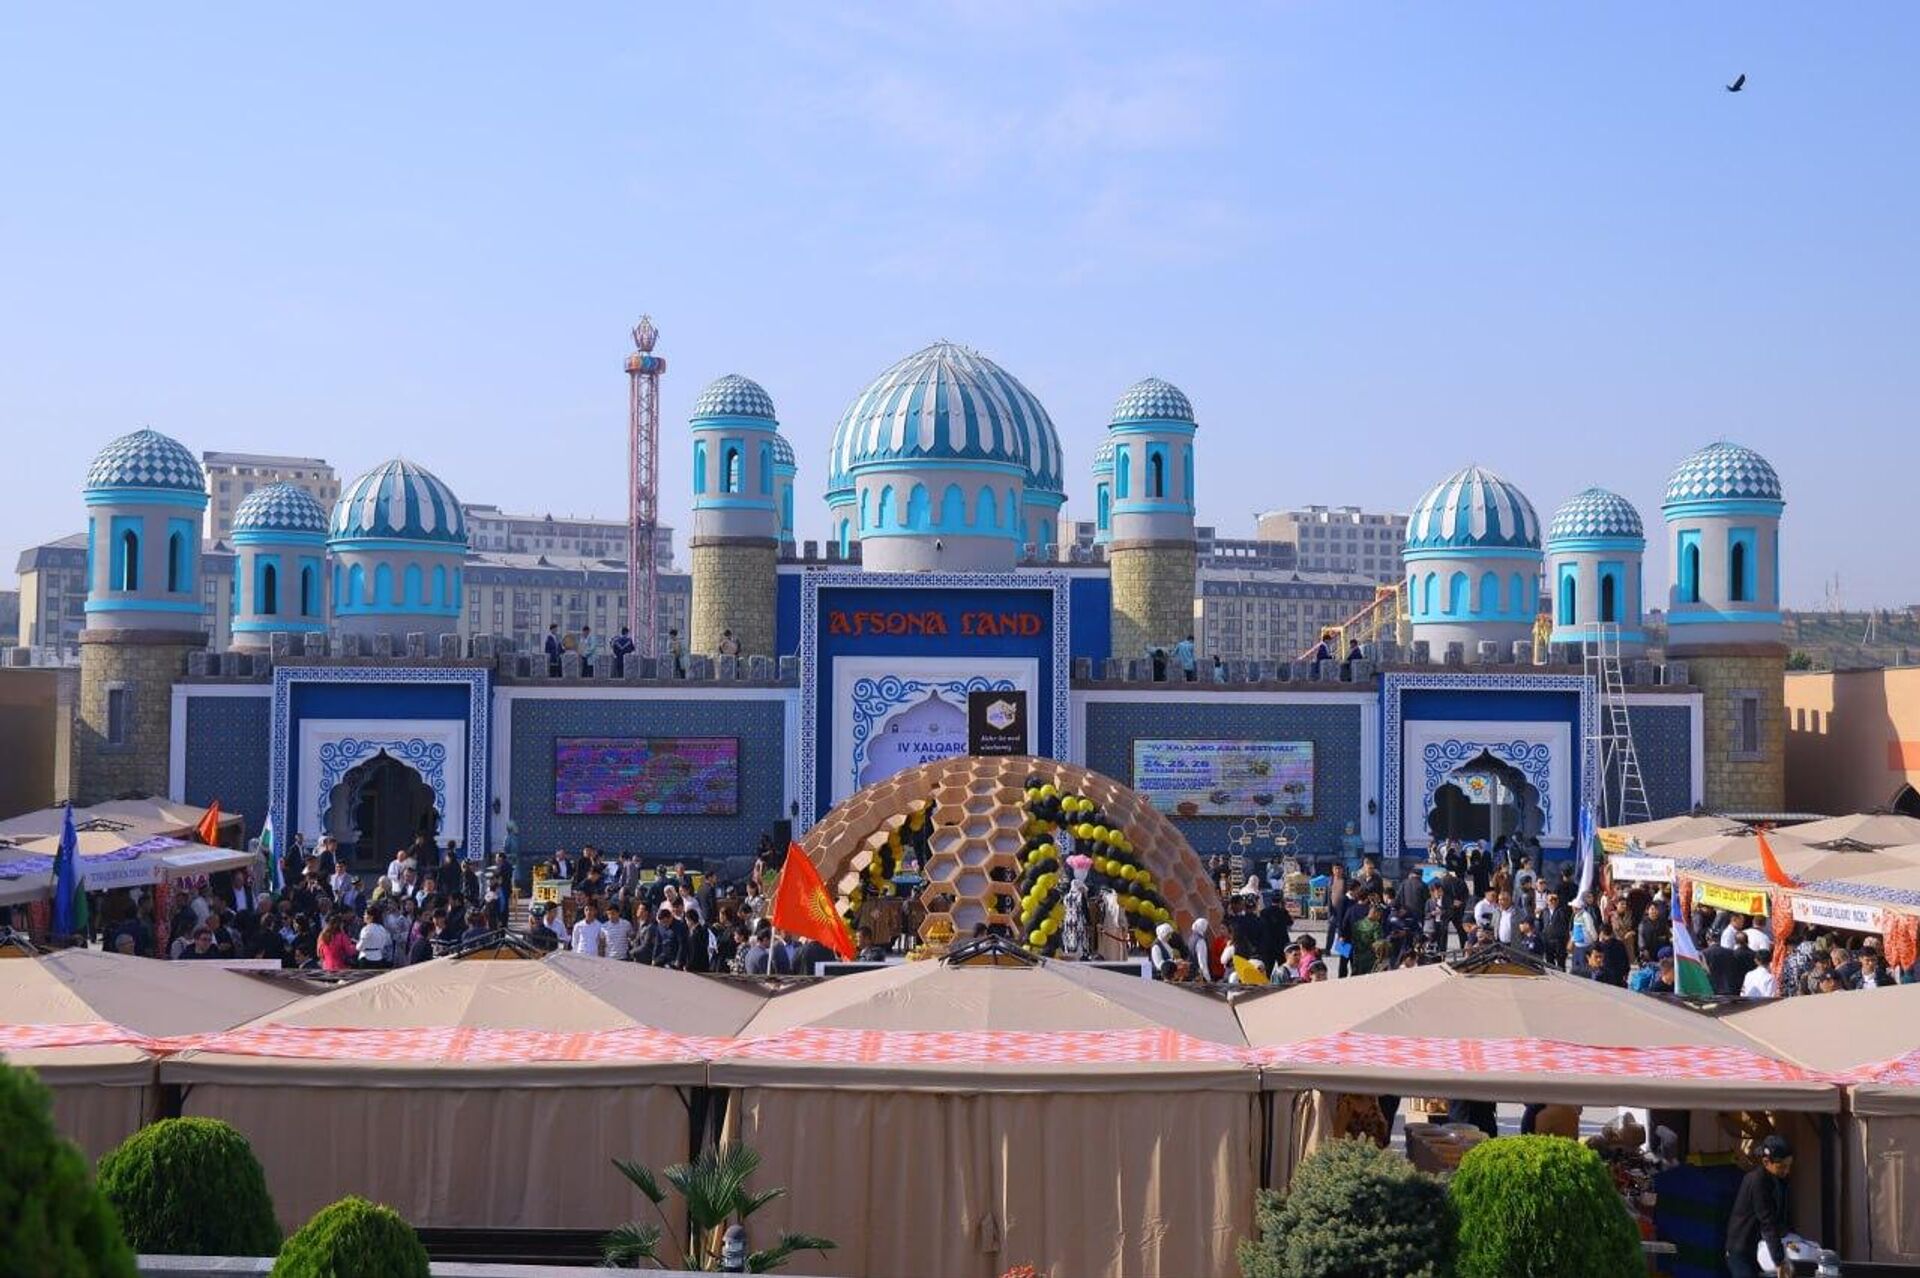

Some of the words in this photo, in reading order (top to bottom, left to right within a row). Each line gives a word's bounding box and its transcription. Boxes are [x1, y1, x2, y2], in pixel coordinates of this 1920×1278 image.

[829, 611, 948, 636] AFSONA
[960, 611, 1043, 636] LAND
[897, 742, 910, 753] IV
